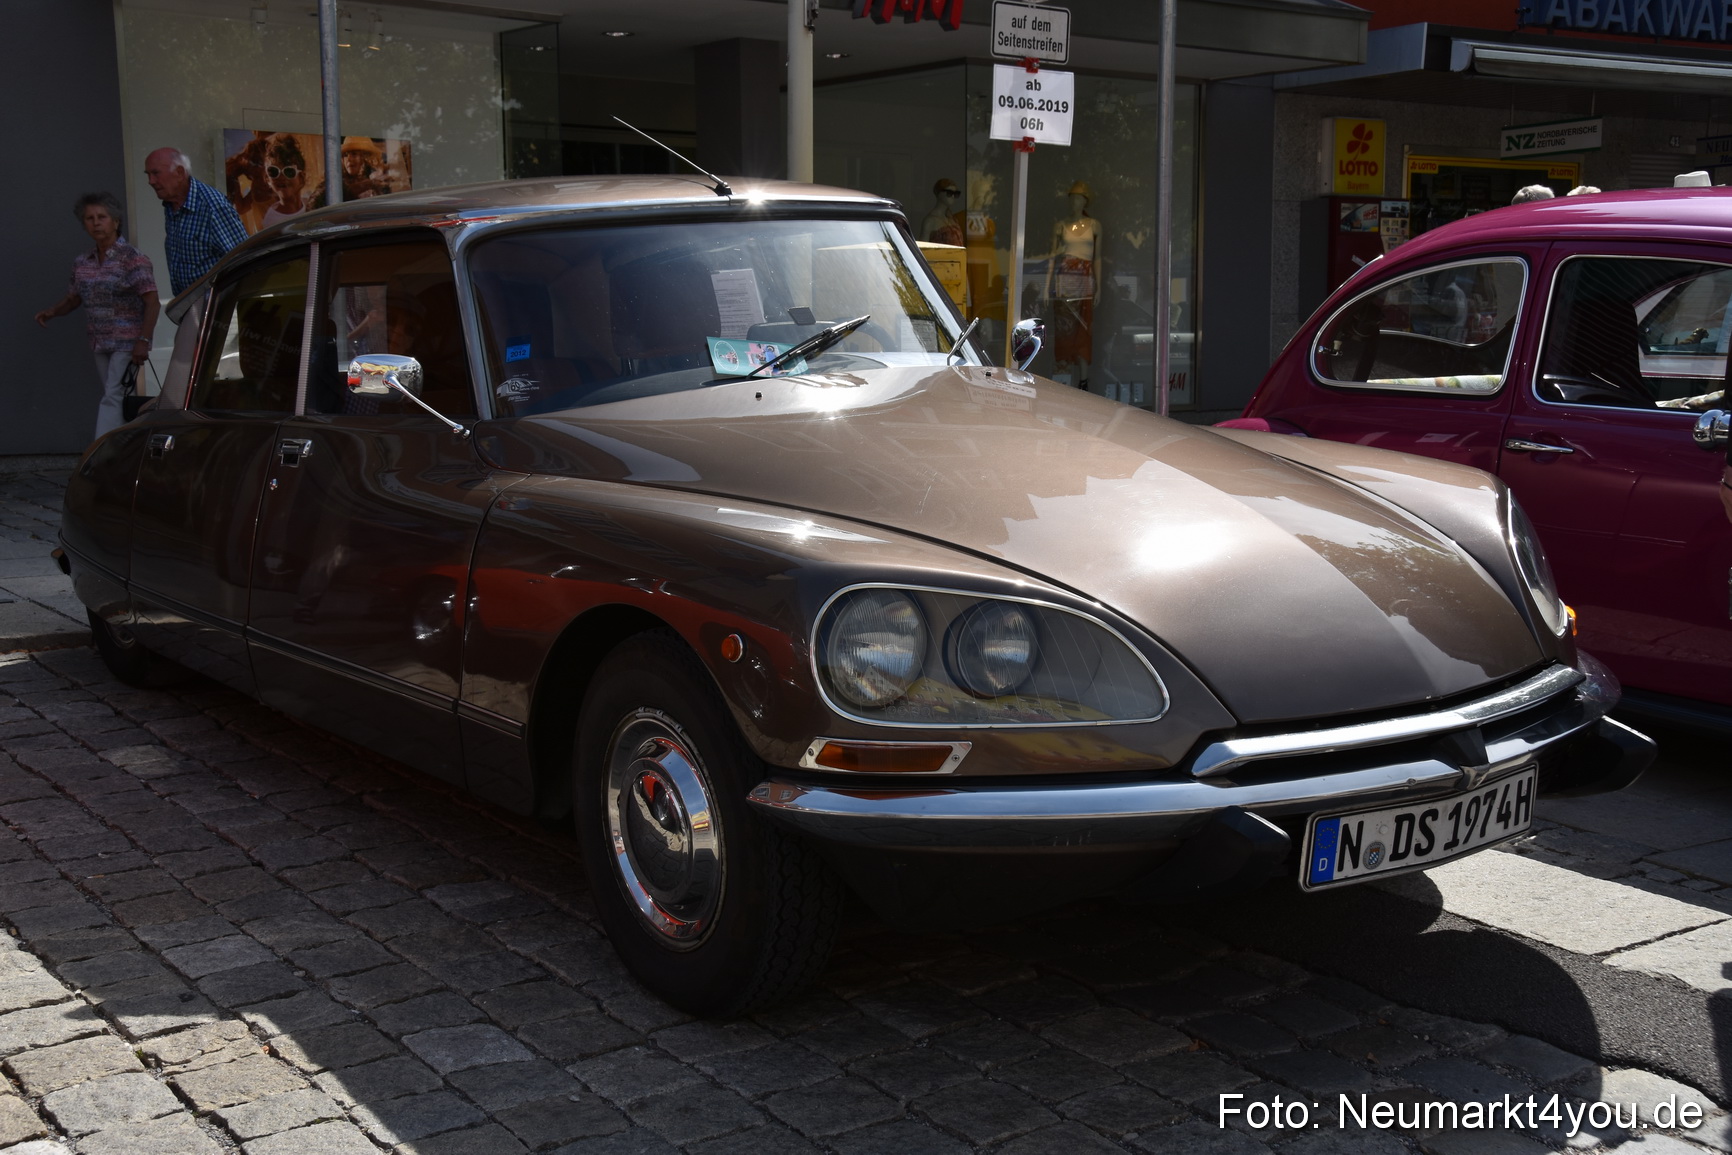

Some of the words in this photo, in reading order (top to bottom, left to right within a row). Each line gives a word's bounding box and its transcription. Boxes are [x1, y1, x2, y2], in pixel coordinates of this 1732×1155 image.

[1011, 15, 1027, 29] auf
[1031, 16, 1051, 32] dem
[997, 31, 1063, 53] Seitenstreifen
[1026, 79, 1041, 91] ab
[998, 95, 1069, 113] 09.06.2019
[1020, 117, 1044, 131] 06h
[1505, 133, 1536, 151] NZ
[1537, 125, 1598, 139] NORDBAYERISCHE
[1537, 138, 1566, 148] ZEITUNG
[1339, 160, 1378, 176] LOTTO
[1418, 162, 1437, 171] LOTTO
[1556, 168, 1574, 177] LOTTO
[510, 349, 527, 358] 2012
[1318, 857, 1329, 872] D
[1337, 820, 1364, 873] N
